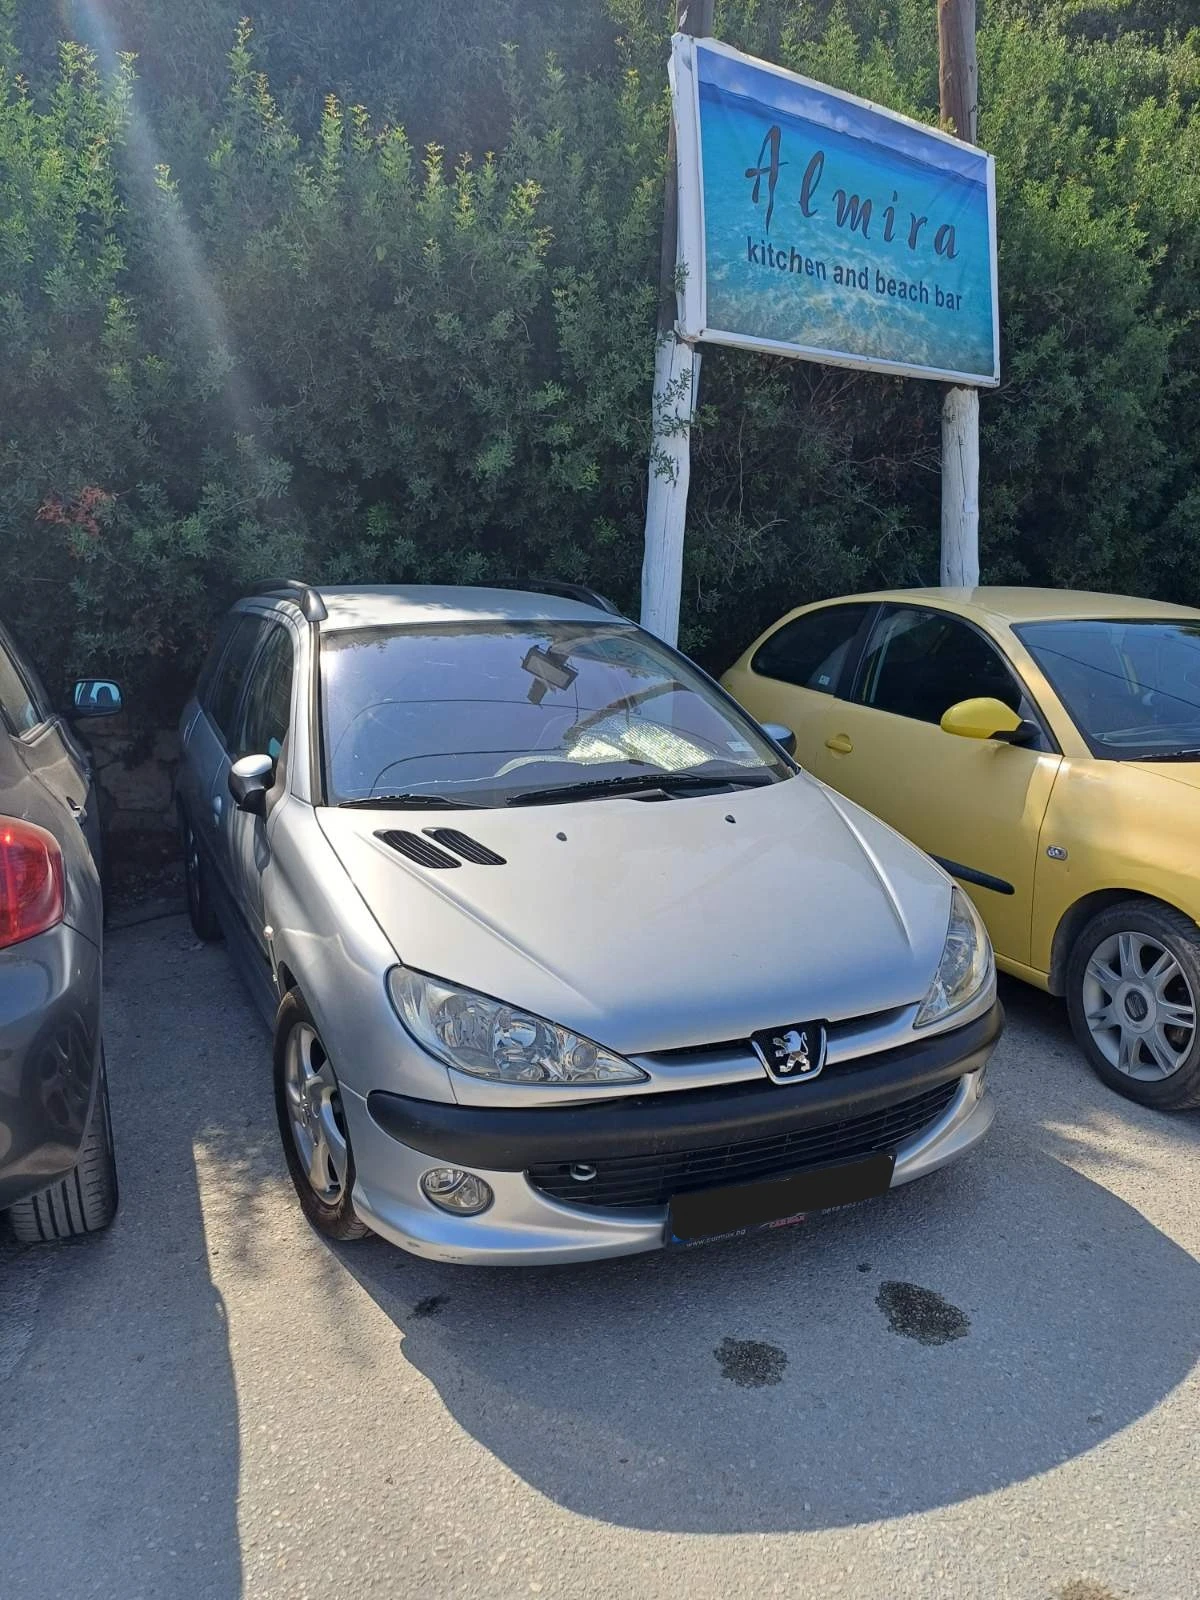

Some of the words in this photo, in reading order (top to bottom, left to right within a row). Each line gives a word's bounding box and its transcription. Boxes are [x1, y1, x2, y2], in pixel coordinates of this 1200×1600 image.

[745, 125, 959, 259] Almira
[747, 236, 827, 281] kitchen
[833, 265, 869, 290] and
[875, 269, 929, 304] beach
[935, 284, 962, 310] bar
